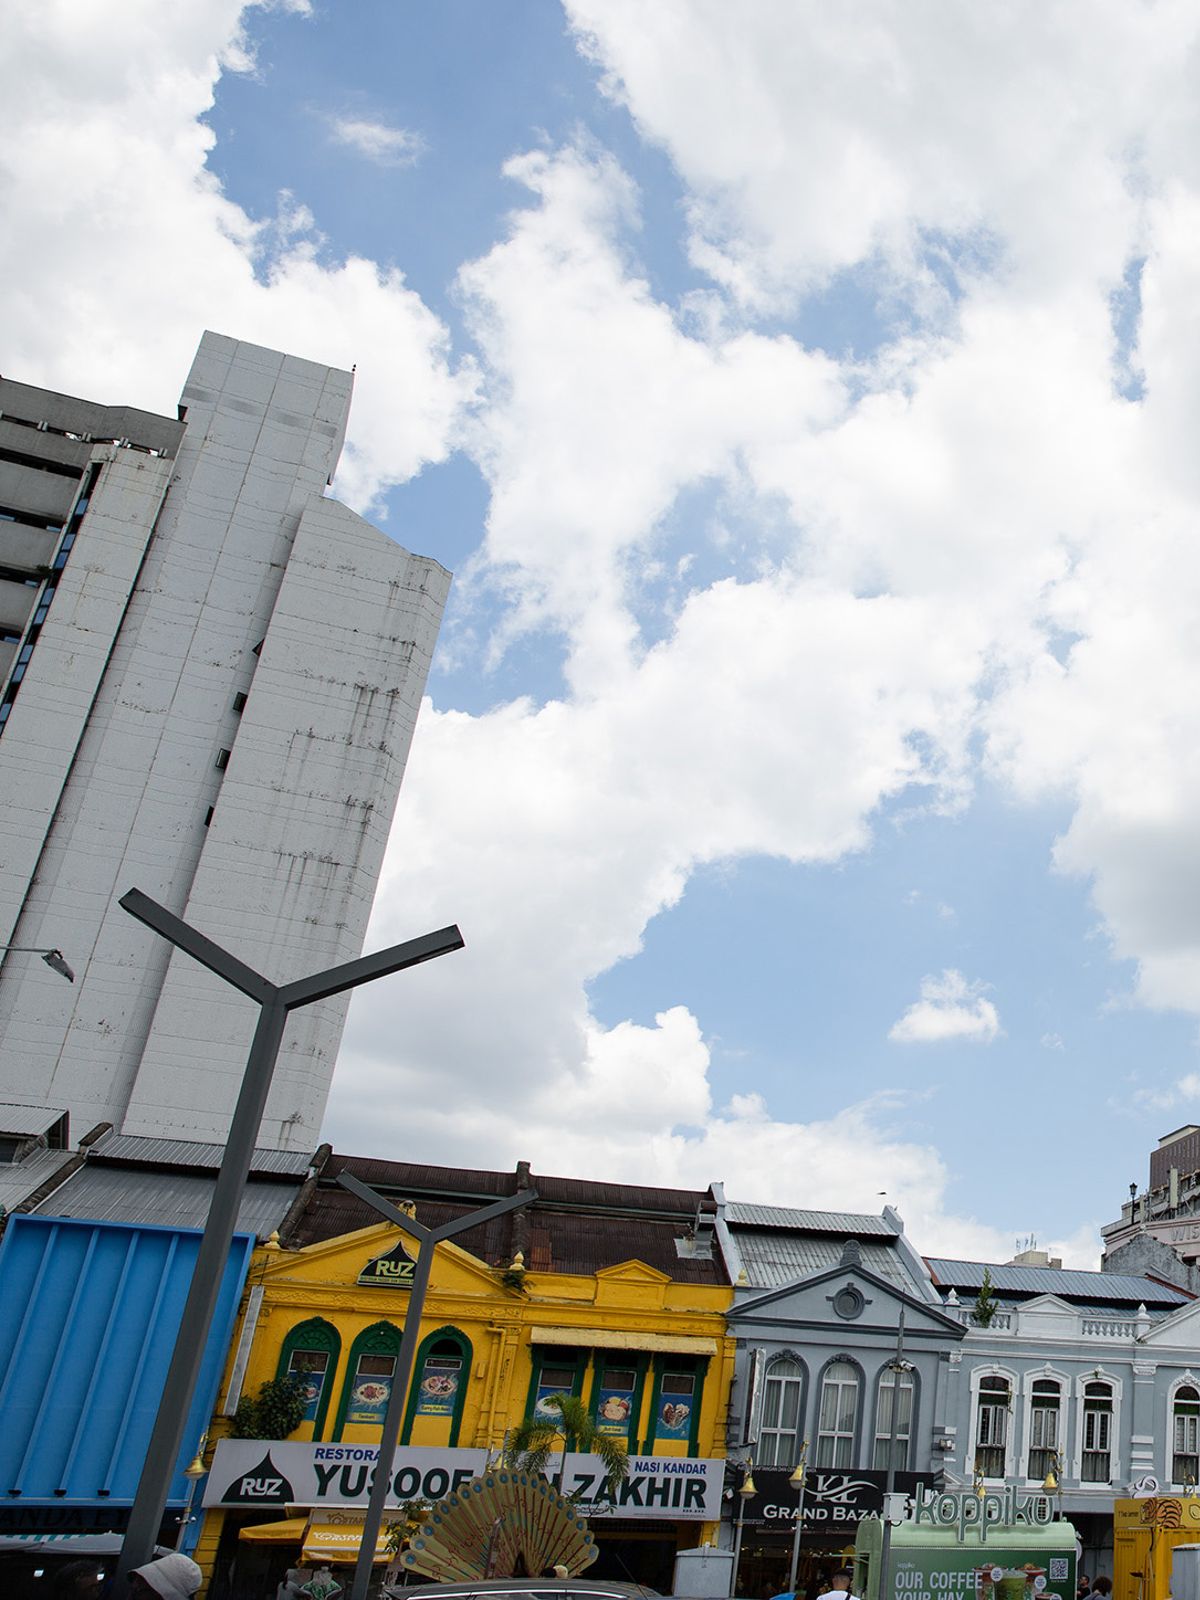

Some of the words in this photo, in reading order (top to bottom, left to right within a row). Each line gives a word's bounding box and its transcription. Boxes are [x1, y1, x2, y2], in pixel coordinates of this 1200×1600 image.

[314, 1448, 381, 1461] RESTORA
[634, 1461, 660, 1472] NASI
[662, 1462, 707, 1475] KANDAR
[572, 1473, 707, 1509] ZAKHIR
[763, 1504, 829, 1521] GRAND
[832, 1506, 879, 1522] BAZA
[914, 1482, 1054, 1543] koppiku
[895, 1571, 923, 1590] OUR
[929, 1571, 983, 1589] COFFEE
